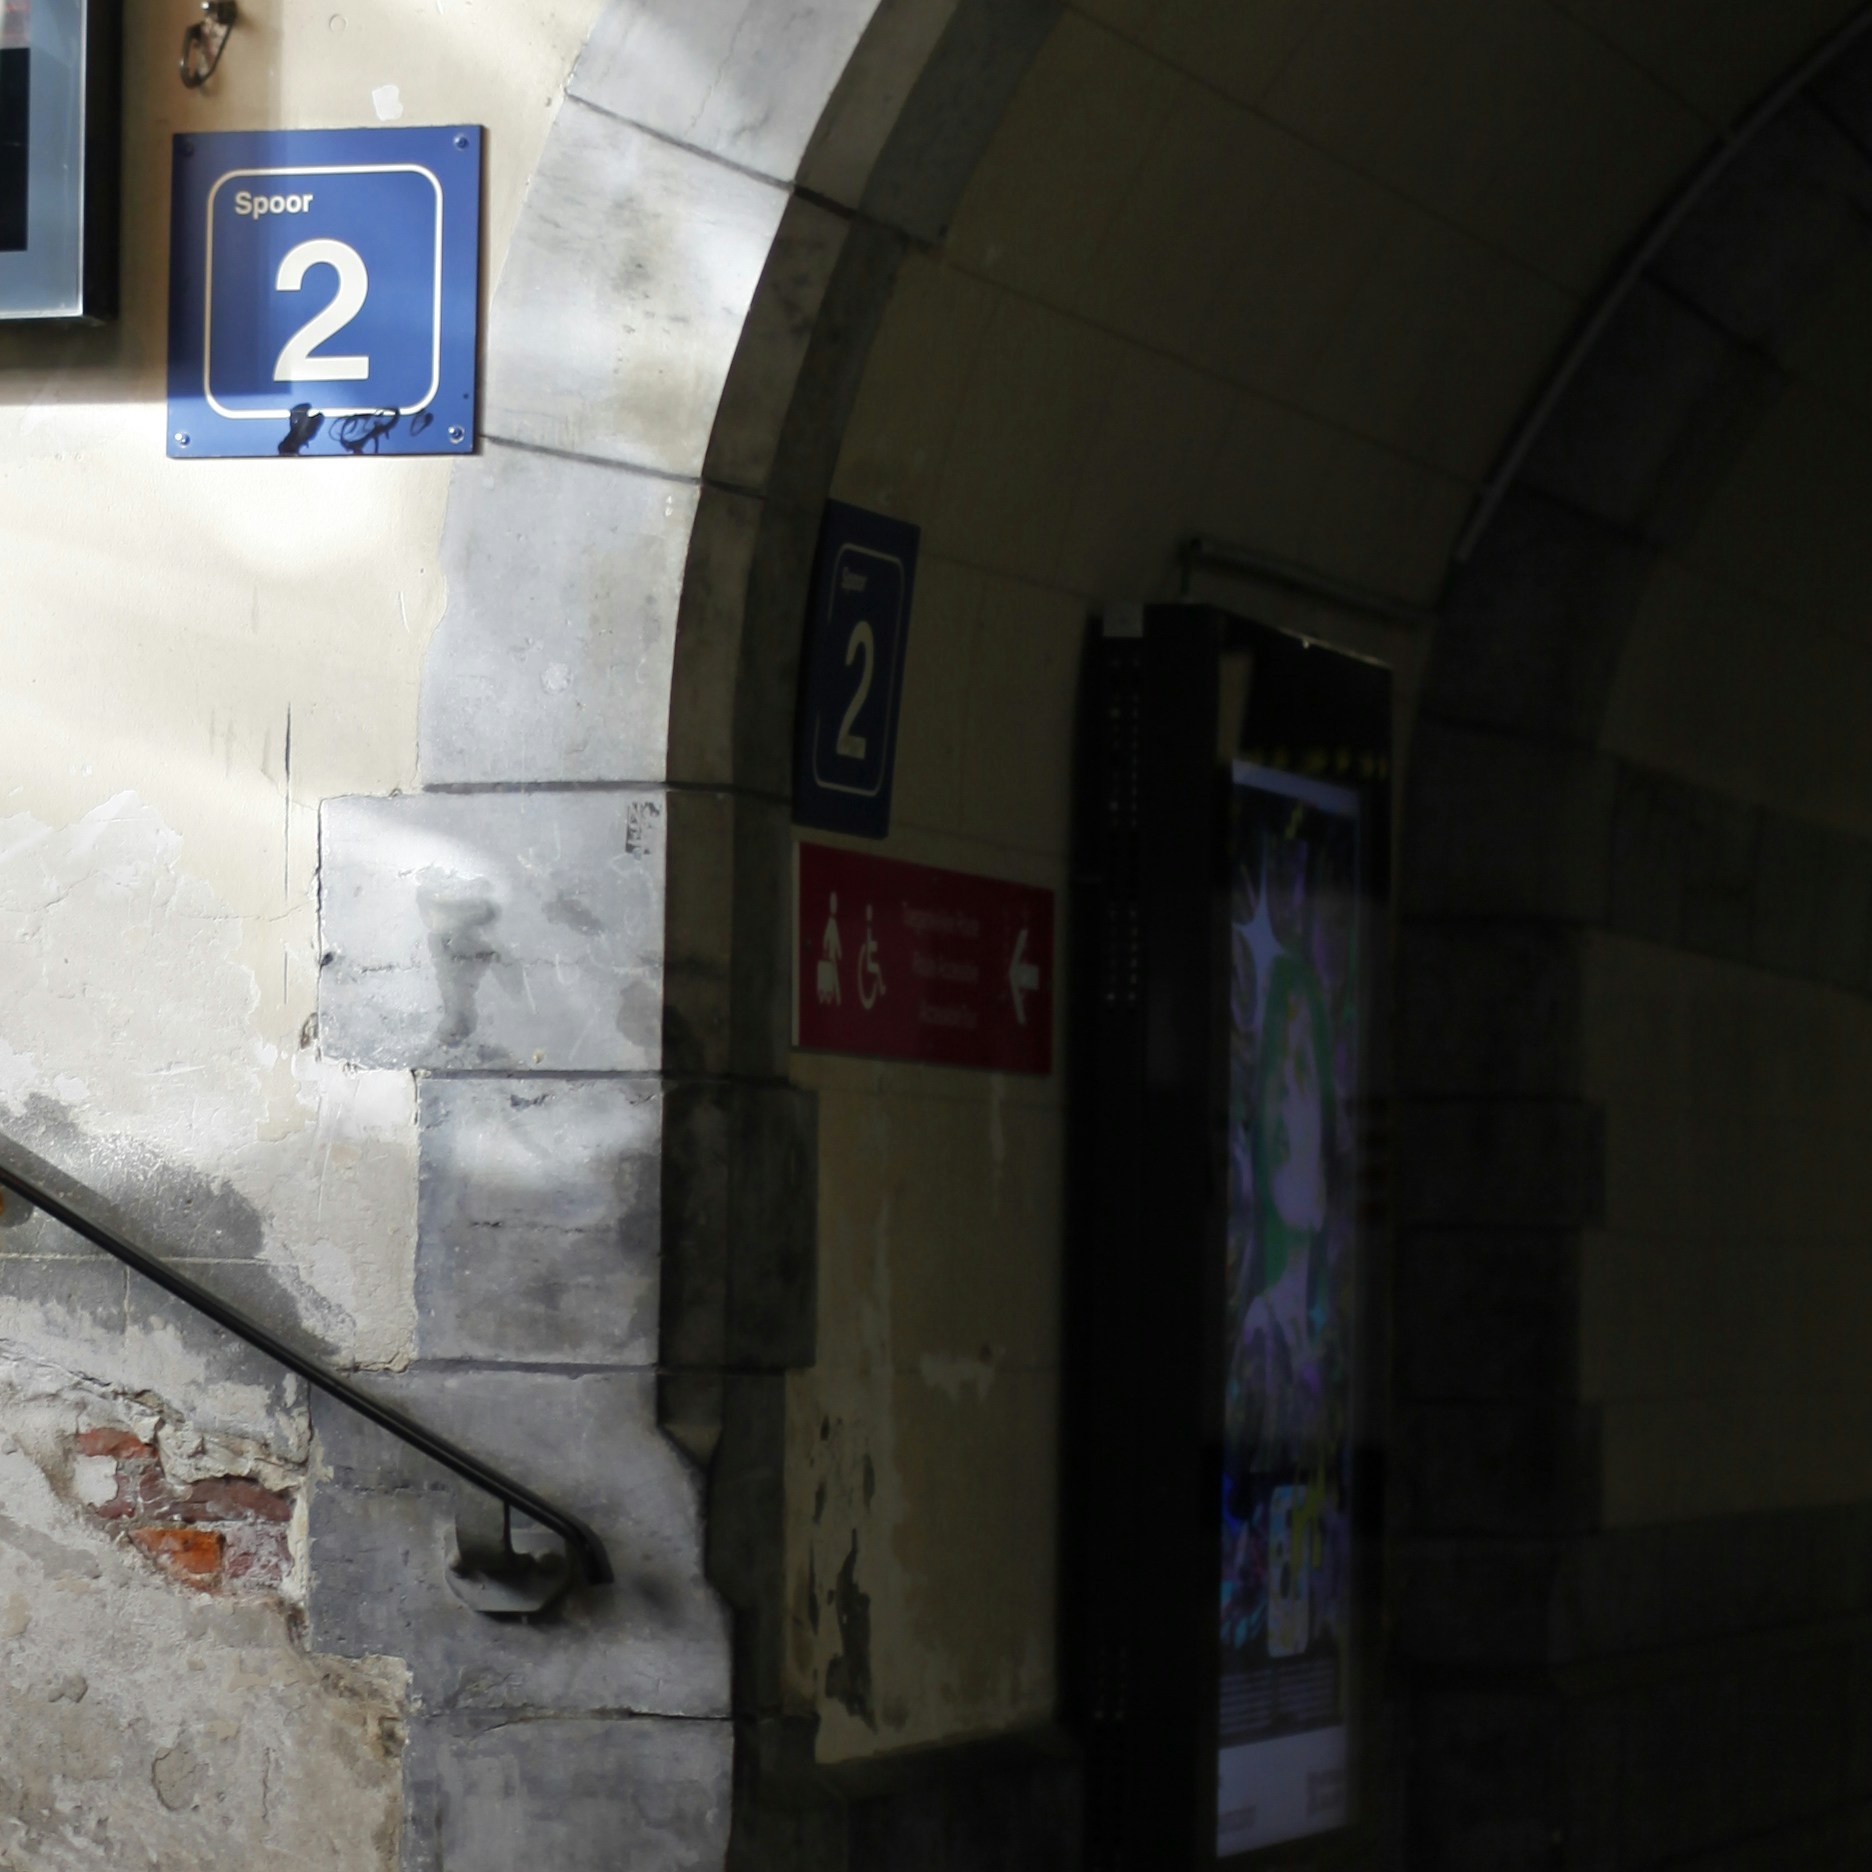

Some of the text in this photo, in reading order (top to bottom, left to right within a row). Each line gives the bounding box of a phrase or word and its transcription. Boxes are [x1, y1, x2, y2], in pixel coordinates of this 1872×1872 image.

[235, 191, 314, 220] Spoor
[273, 238, 370, 382] 2
[835, 619, 875, 761] 2
